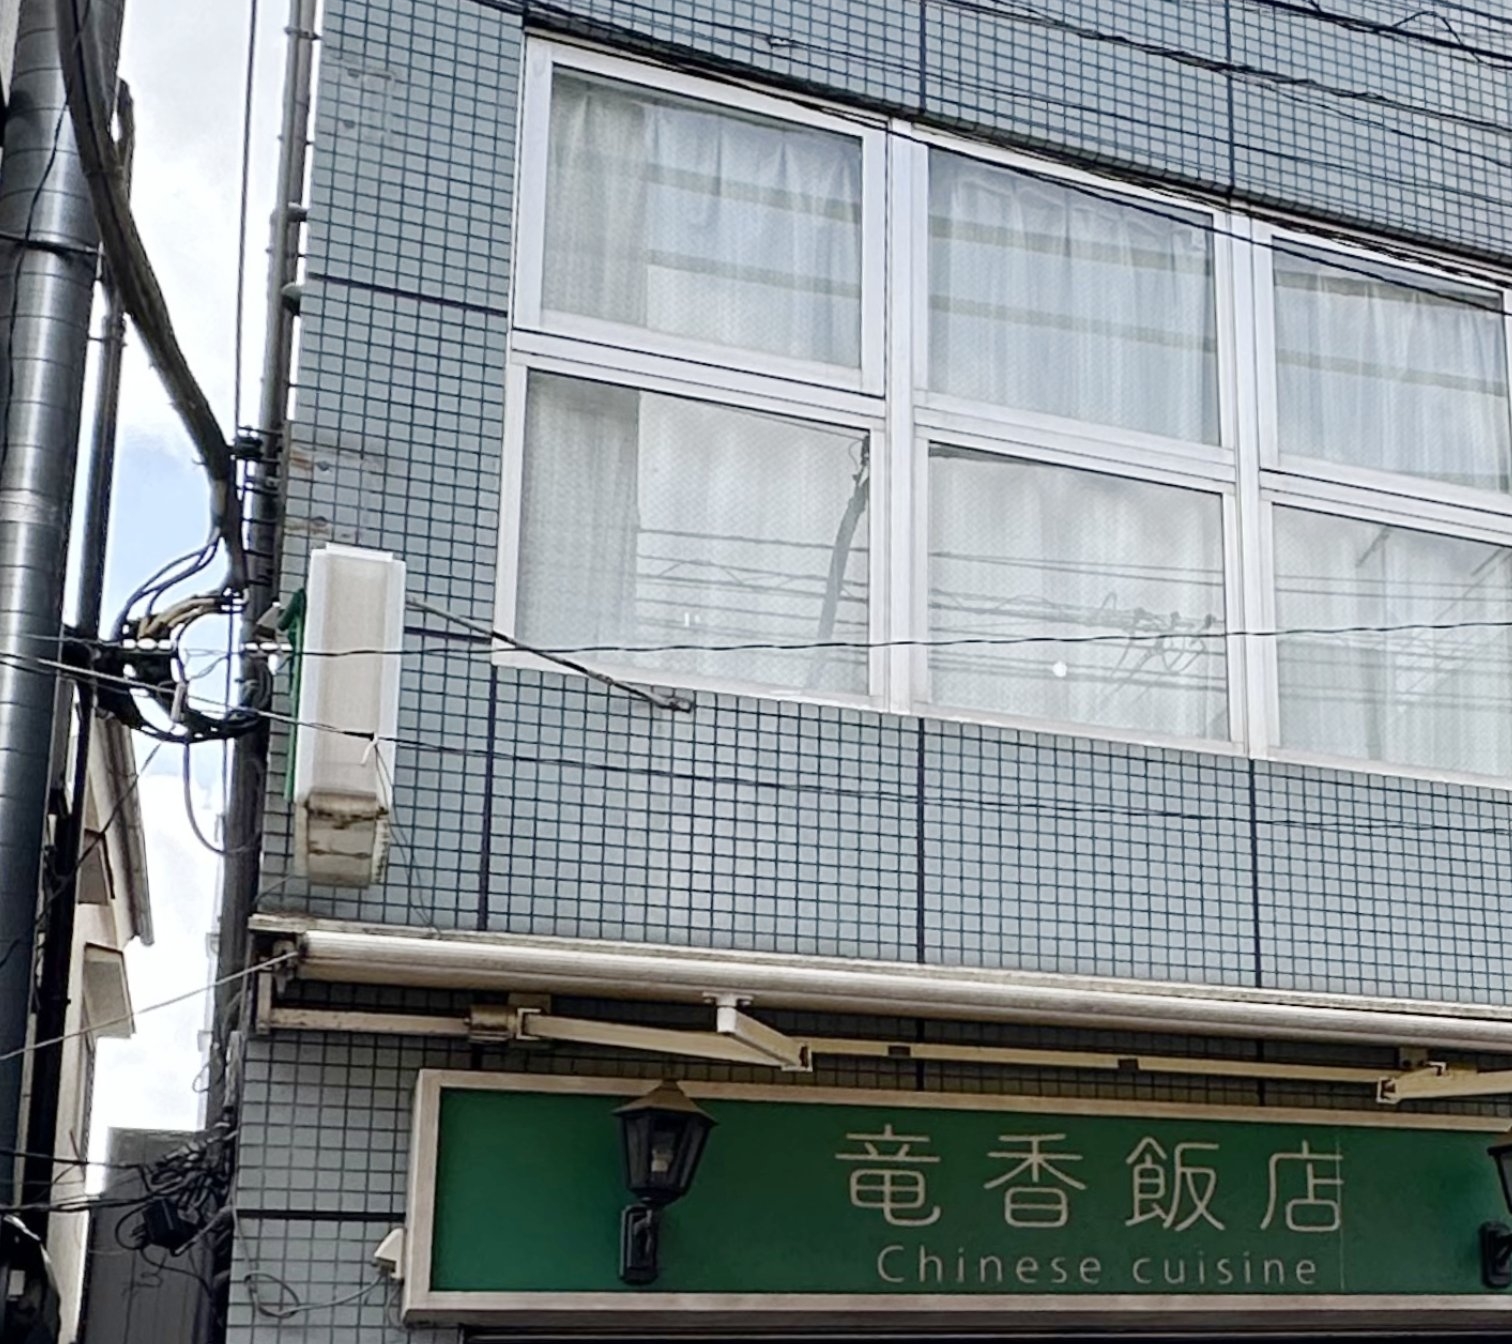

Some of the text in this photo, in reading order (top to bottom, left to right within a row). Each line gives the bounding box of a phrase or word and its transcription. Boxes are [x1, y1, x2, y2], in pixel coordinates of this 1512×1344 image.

[834, 1123, 1345, 1233] 竜香飯店
[876, 1244, 1317, 1286] Chinese cuisine
